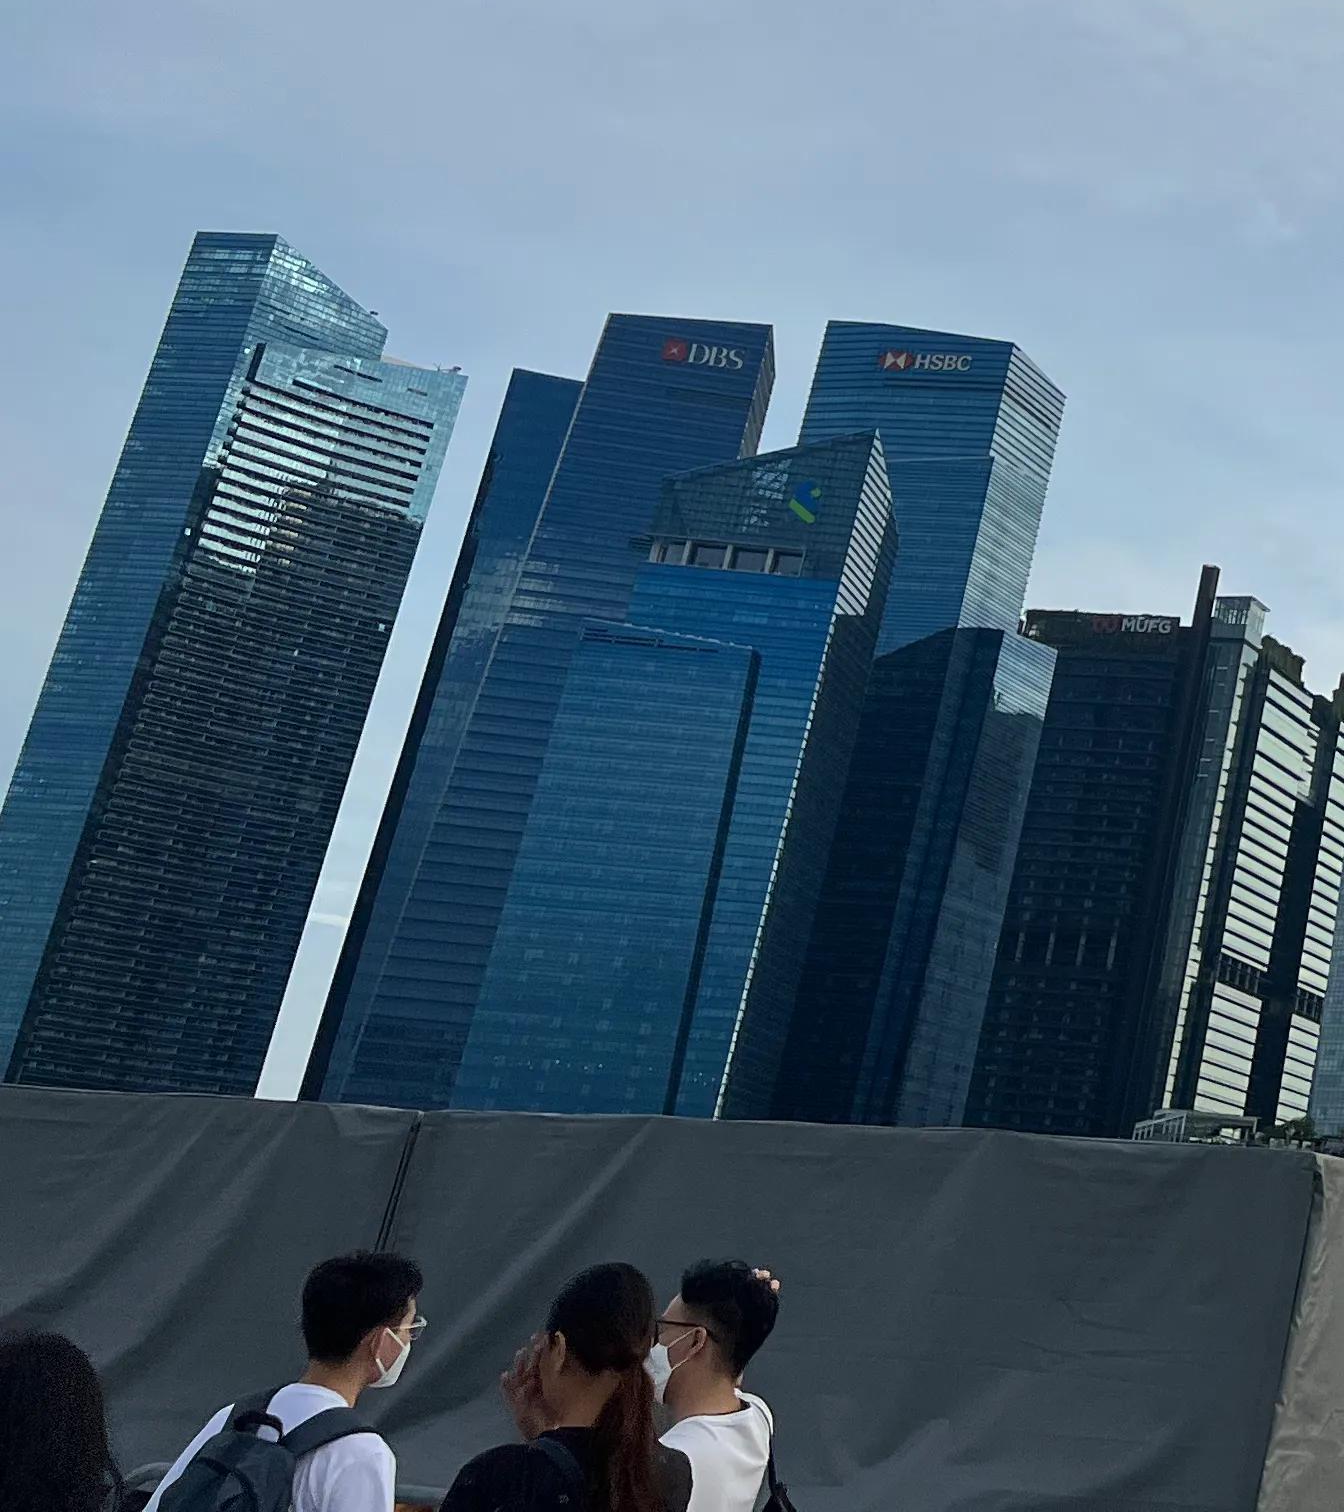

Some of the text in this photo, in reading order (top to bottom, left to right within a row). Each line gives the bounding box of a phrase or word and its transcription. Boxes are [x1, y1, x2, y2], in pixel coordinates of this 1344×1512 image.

[687, 342, 745, 370] DBS
[914, 353, 972, 371] HSBC
[1121, 617, 1171, 634] MUFG
